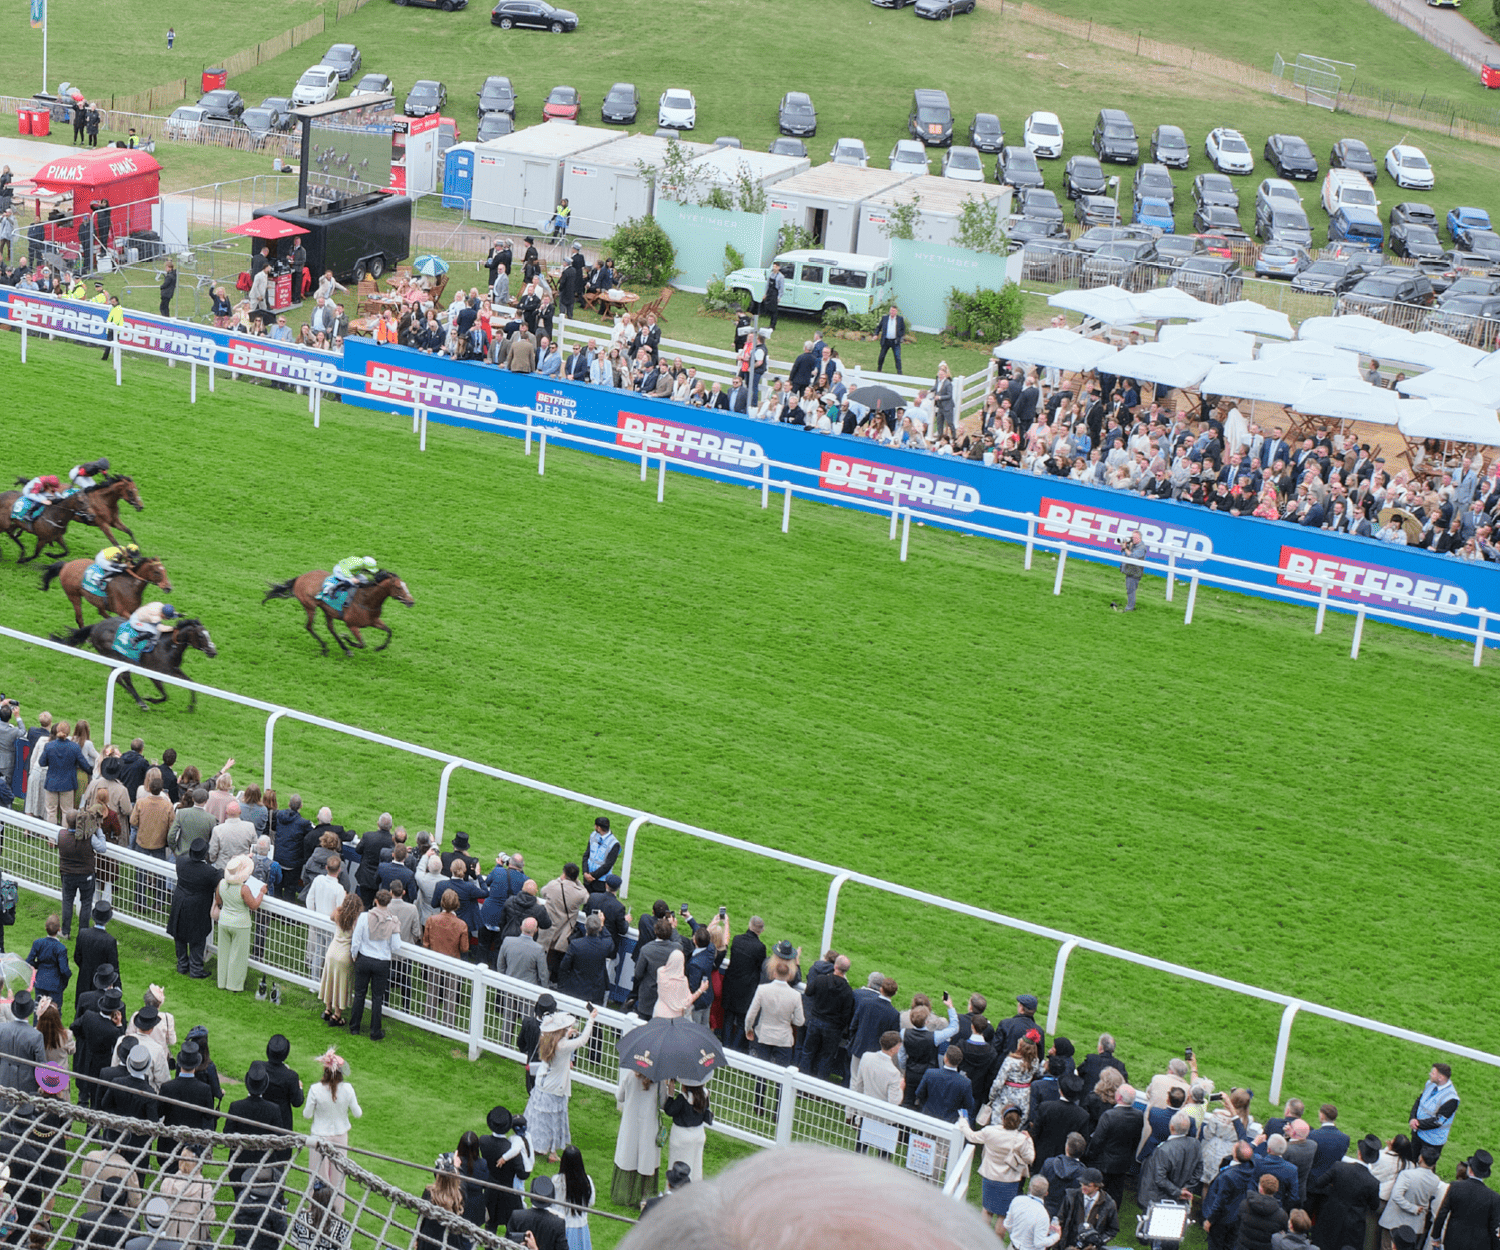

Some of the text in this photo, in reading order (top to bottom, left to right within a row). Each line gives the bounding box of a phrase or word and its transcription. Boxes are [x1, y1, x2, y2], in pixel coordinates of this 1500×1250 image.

[46, 165, 86, 180] PIMM'S
[679, 213, 738, 228] NYETIMBER
[915, 252, 978, 268] NYETIMBER
[11, 299, 104, 335] BETFRED
[119, 321, 217, 359] BETFRED
[232, 344, 338, 384] BETFRED
[370, 366, 498, 413] BETFRED
[538, 393, 577, 407] BETFRED
[535, 403, 577, 419] DERBY
[622, 417, 765, 468] BETFRED
[825, 458, 980, 513] BETFRED
[1045, 502, 1213, 562] BETFRED
[1284, 552, 1468, 615] BETFRED
